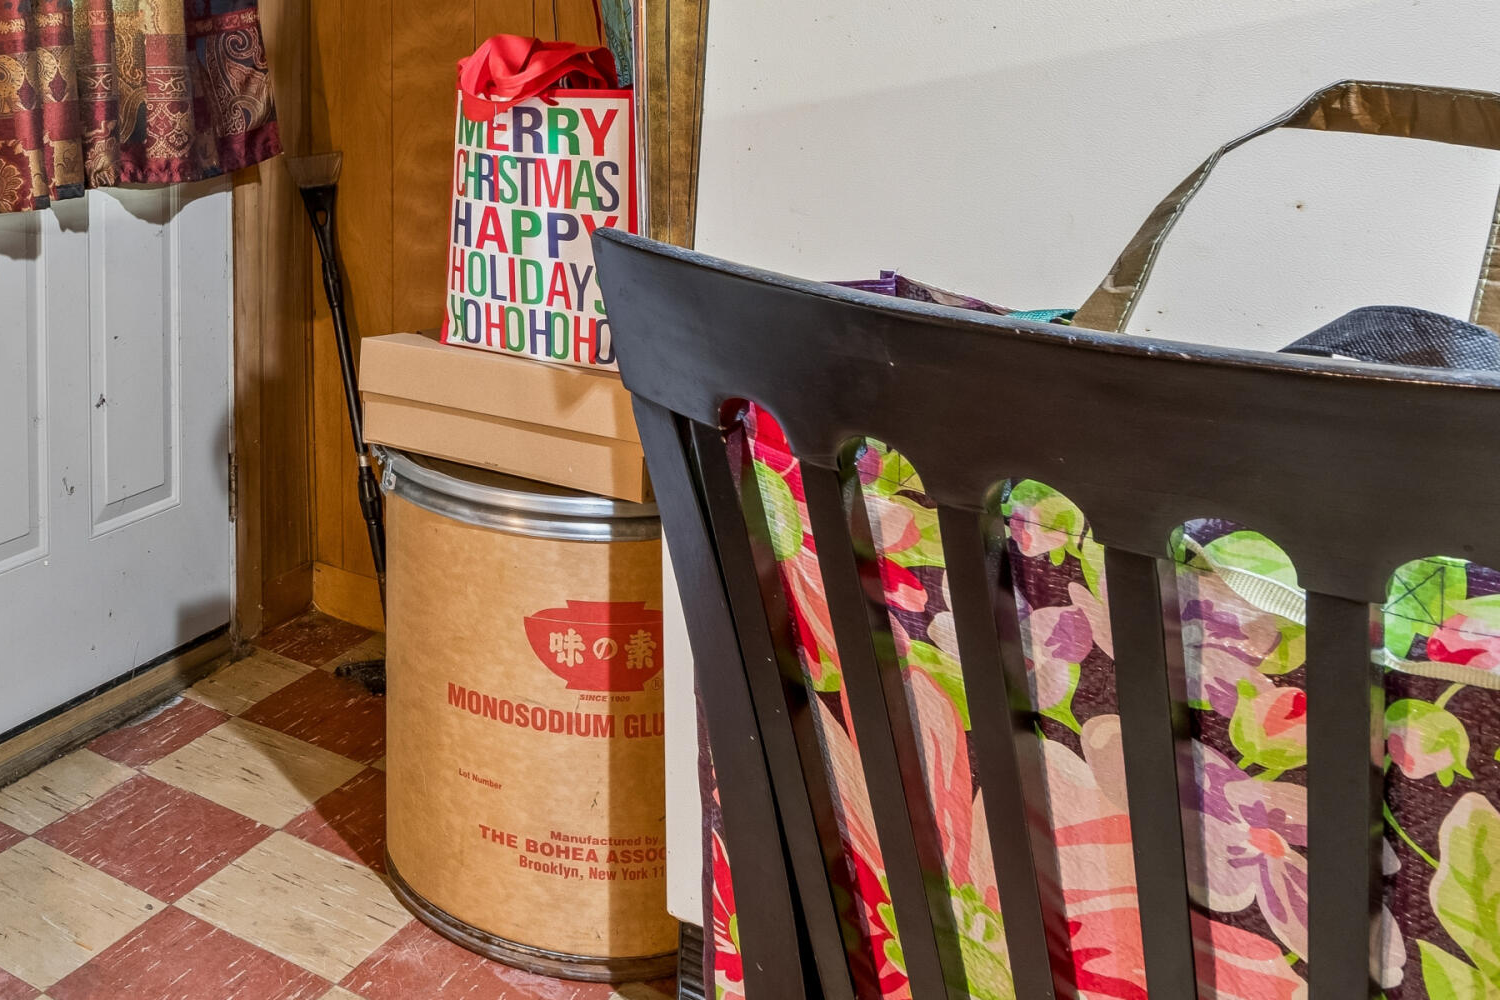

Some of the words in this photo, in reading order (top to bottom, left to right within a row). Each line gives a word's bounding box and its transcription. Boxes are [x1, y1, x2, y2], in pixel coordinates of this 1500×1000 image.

[458, 100, 618, 157] MERRY
[456, 148, 620, 212] CHRISTMAS
[451, 246, 607, 316] HOLIDAY
[548, 627, 658, 670] 味の素
[448, 682, 616, 738] MONOSODIUM
[579, 694, 609, 702] SINCE
[458, 768, 471, 780] Lot
[472, 774, 503, 790] Number
[478, 824, 519, 849] THE
[525, 838, 599, 864] BOHEA
[550, 830, 643, 847] Manufactured
[645, 836, 659, 845] by
[519, 855, 584, 881] Brooklyn,
[588, 867, 617, 881] New
[621, 868, 648, 881] York
